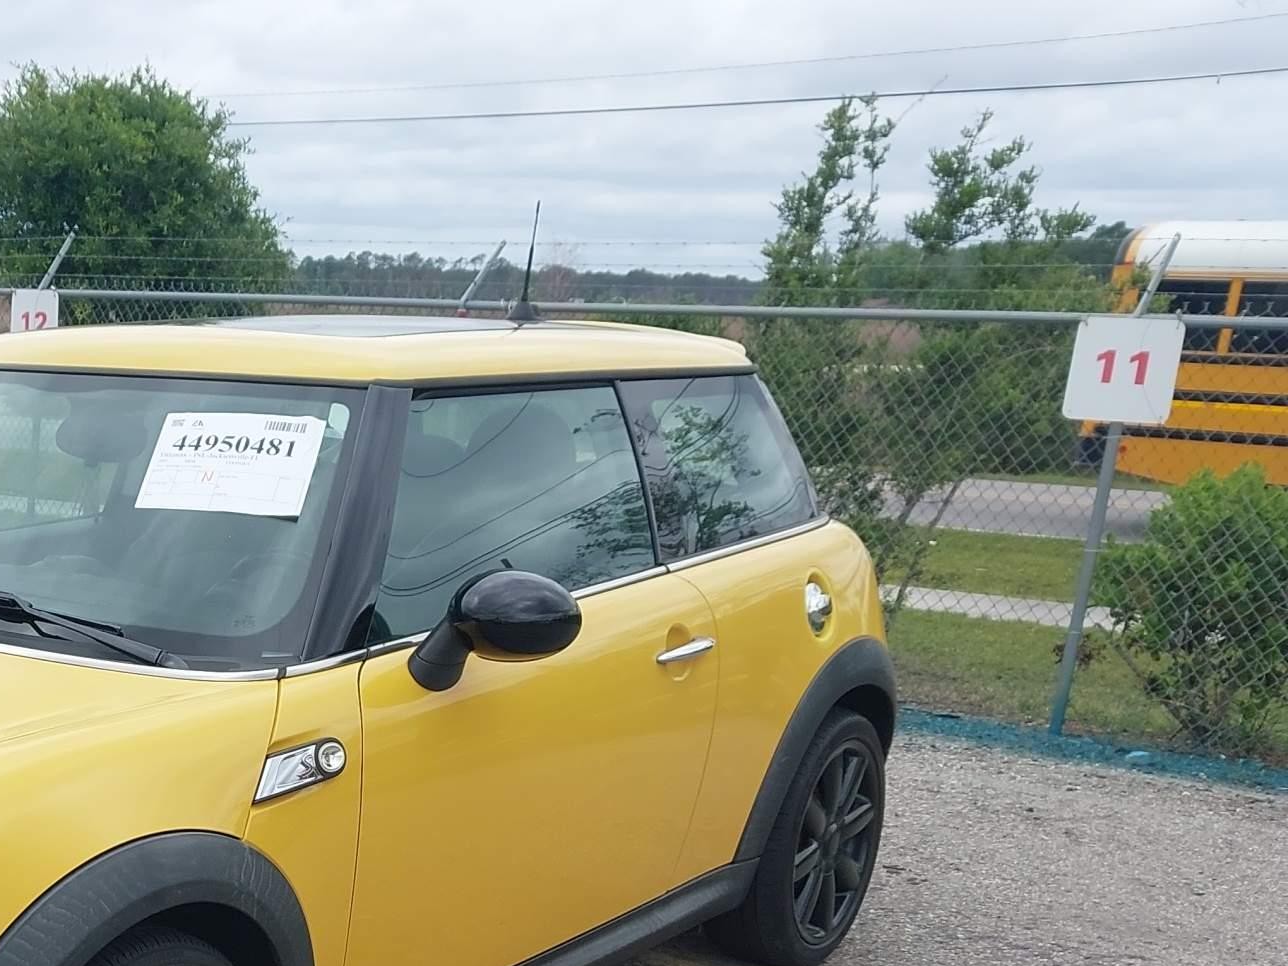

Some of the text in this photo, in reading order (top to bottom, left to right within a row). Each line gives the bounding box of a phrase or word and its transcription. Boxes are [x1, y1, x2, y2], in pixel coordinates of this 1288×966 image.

[21, 311, 47, 330] 12
[1096, 349, 1150, 386] 11
[172, 433, 297, 458] 44950481
